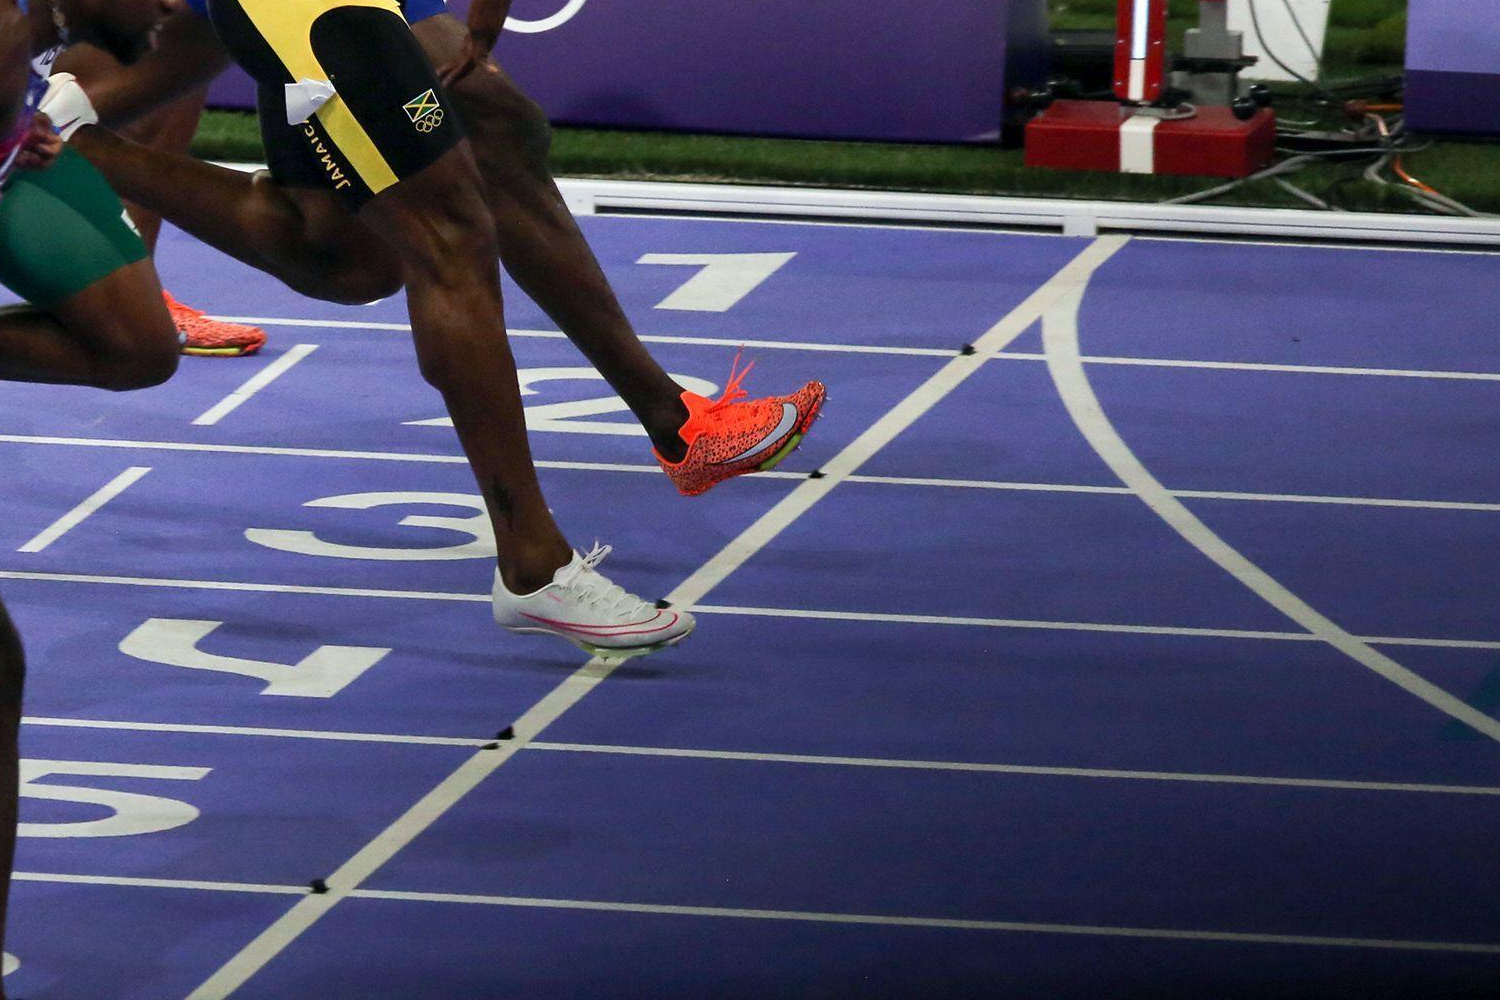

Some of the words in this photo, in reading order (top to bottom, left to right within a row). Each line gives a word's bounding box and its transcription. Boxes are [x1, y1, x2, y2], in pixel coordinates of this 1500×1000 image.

[636, 252, 797, 311] 1
[402, 366, 720, 435] 2
[245, 491, 498, 560] 3
[118, 617, 393, 698] 4
